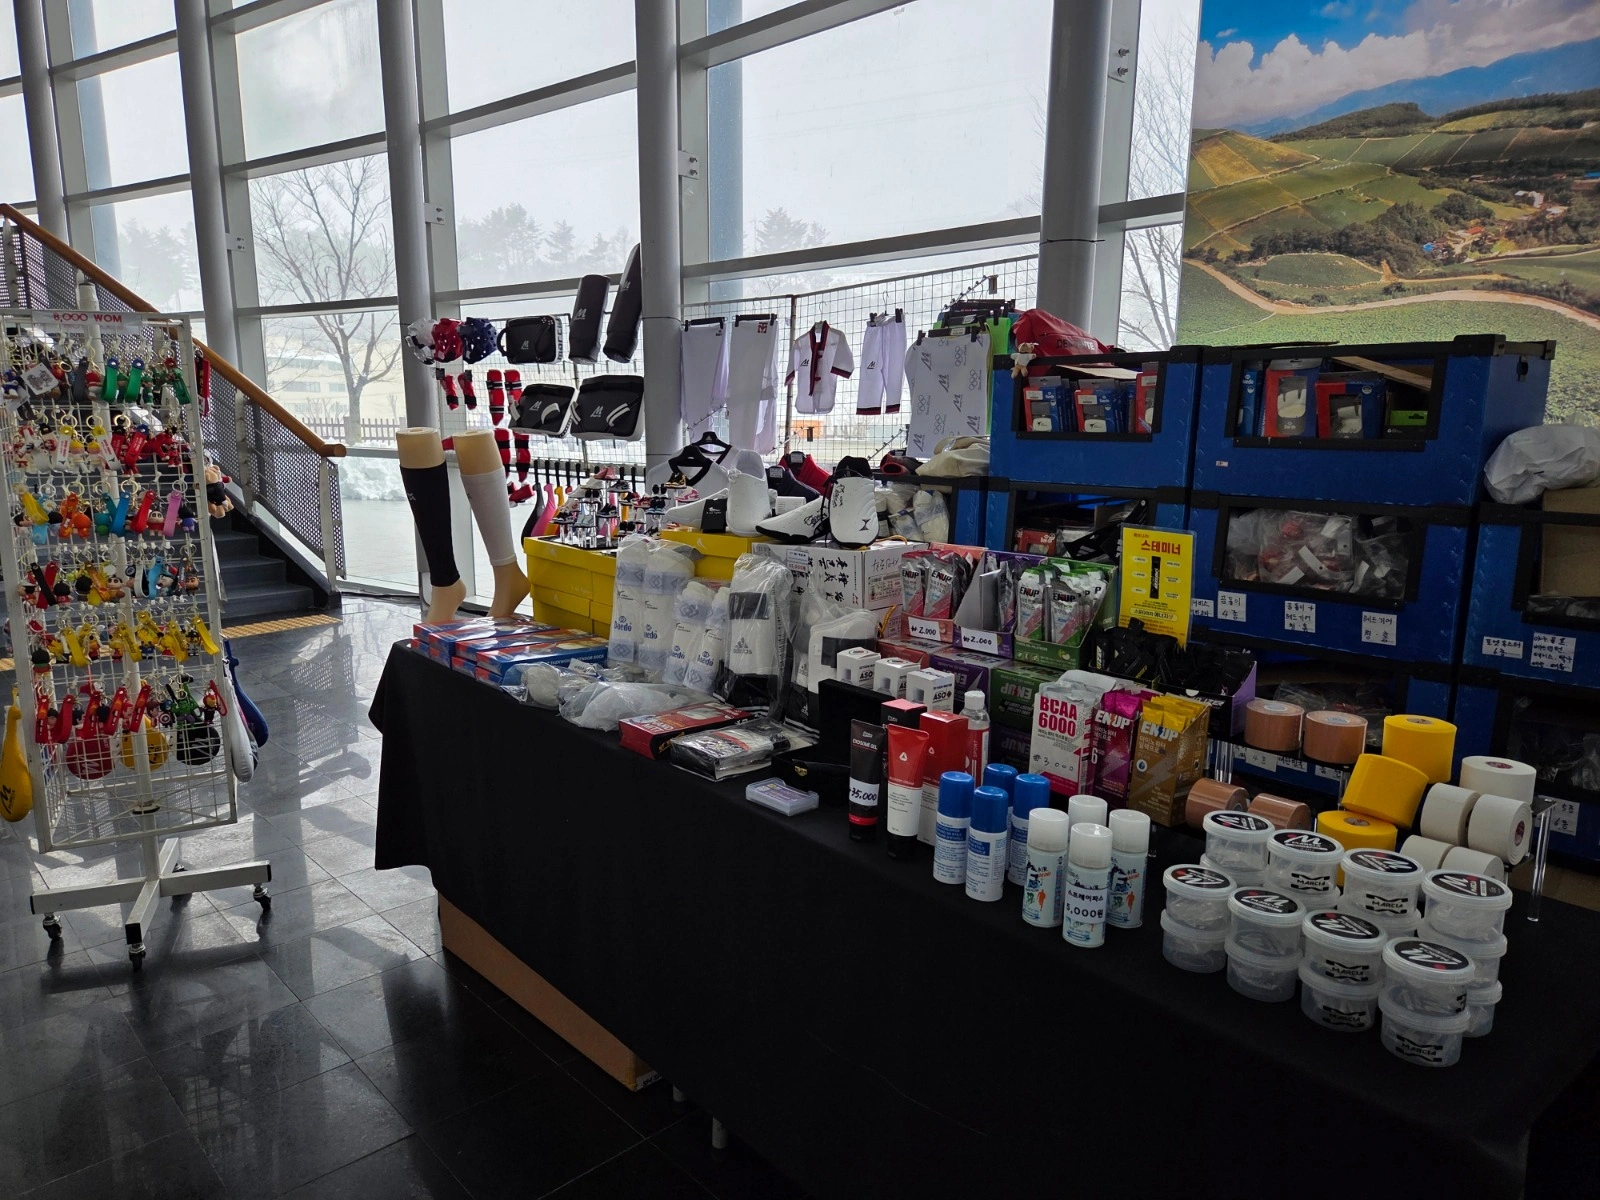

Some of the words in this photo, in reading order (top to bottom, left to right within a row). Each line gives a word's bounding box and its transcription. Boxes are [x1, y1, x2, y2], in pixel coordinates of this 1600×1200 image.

[54, 312, 88, 322] 8,000
[1141, 540, 1180, 555] 스테미너
[860, 671, 873, 680] ASO
[933, 692, 946, 701] ASO
[1039, 695, 1077, 721] BCAA
[1038, 712, 1076, 737] 6000
[1094, 710, 1131, 730] ENUP
[1141, 720, 1179, 742] ENUP
[1296, 879, 1327, 887] MARCIA
[1065, 902, 1104, 919] 5,000원
[1371, 900, 1406, 910] MARCIA
[1331, 966, 1365, 977] MARCIA
[1328, 1012, 1361, 1022] MARCIA
[1401, 1042, 1437, 1057] MARCIA
